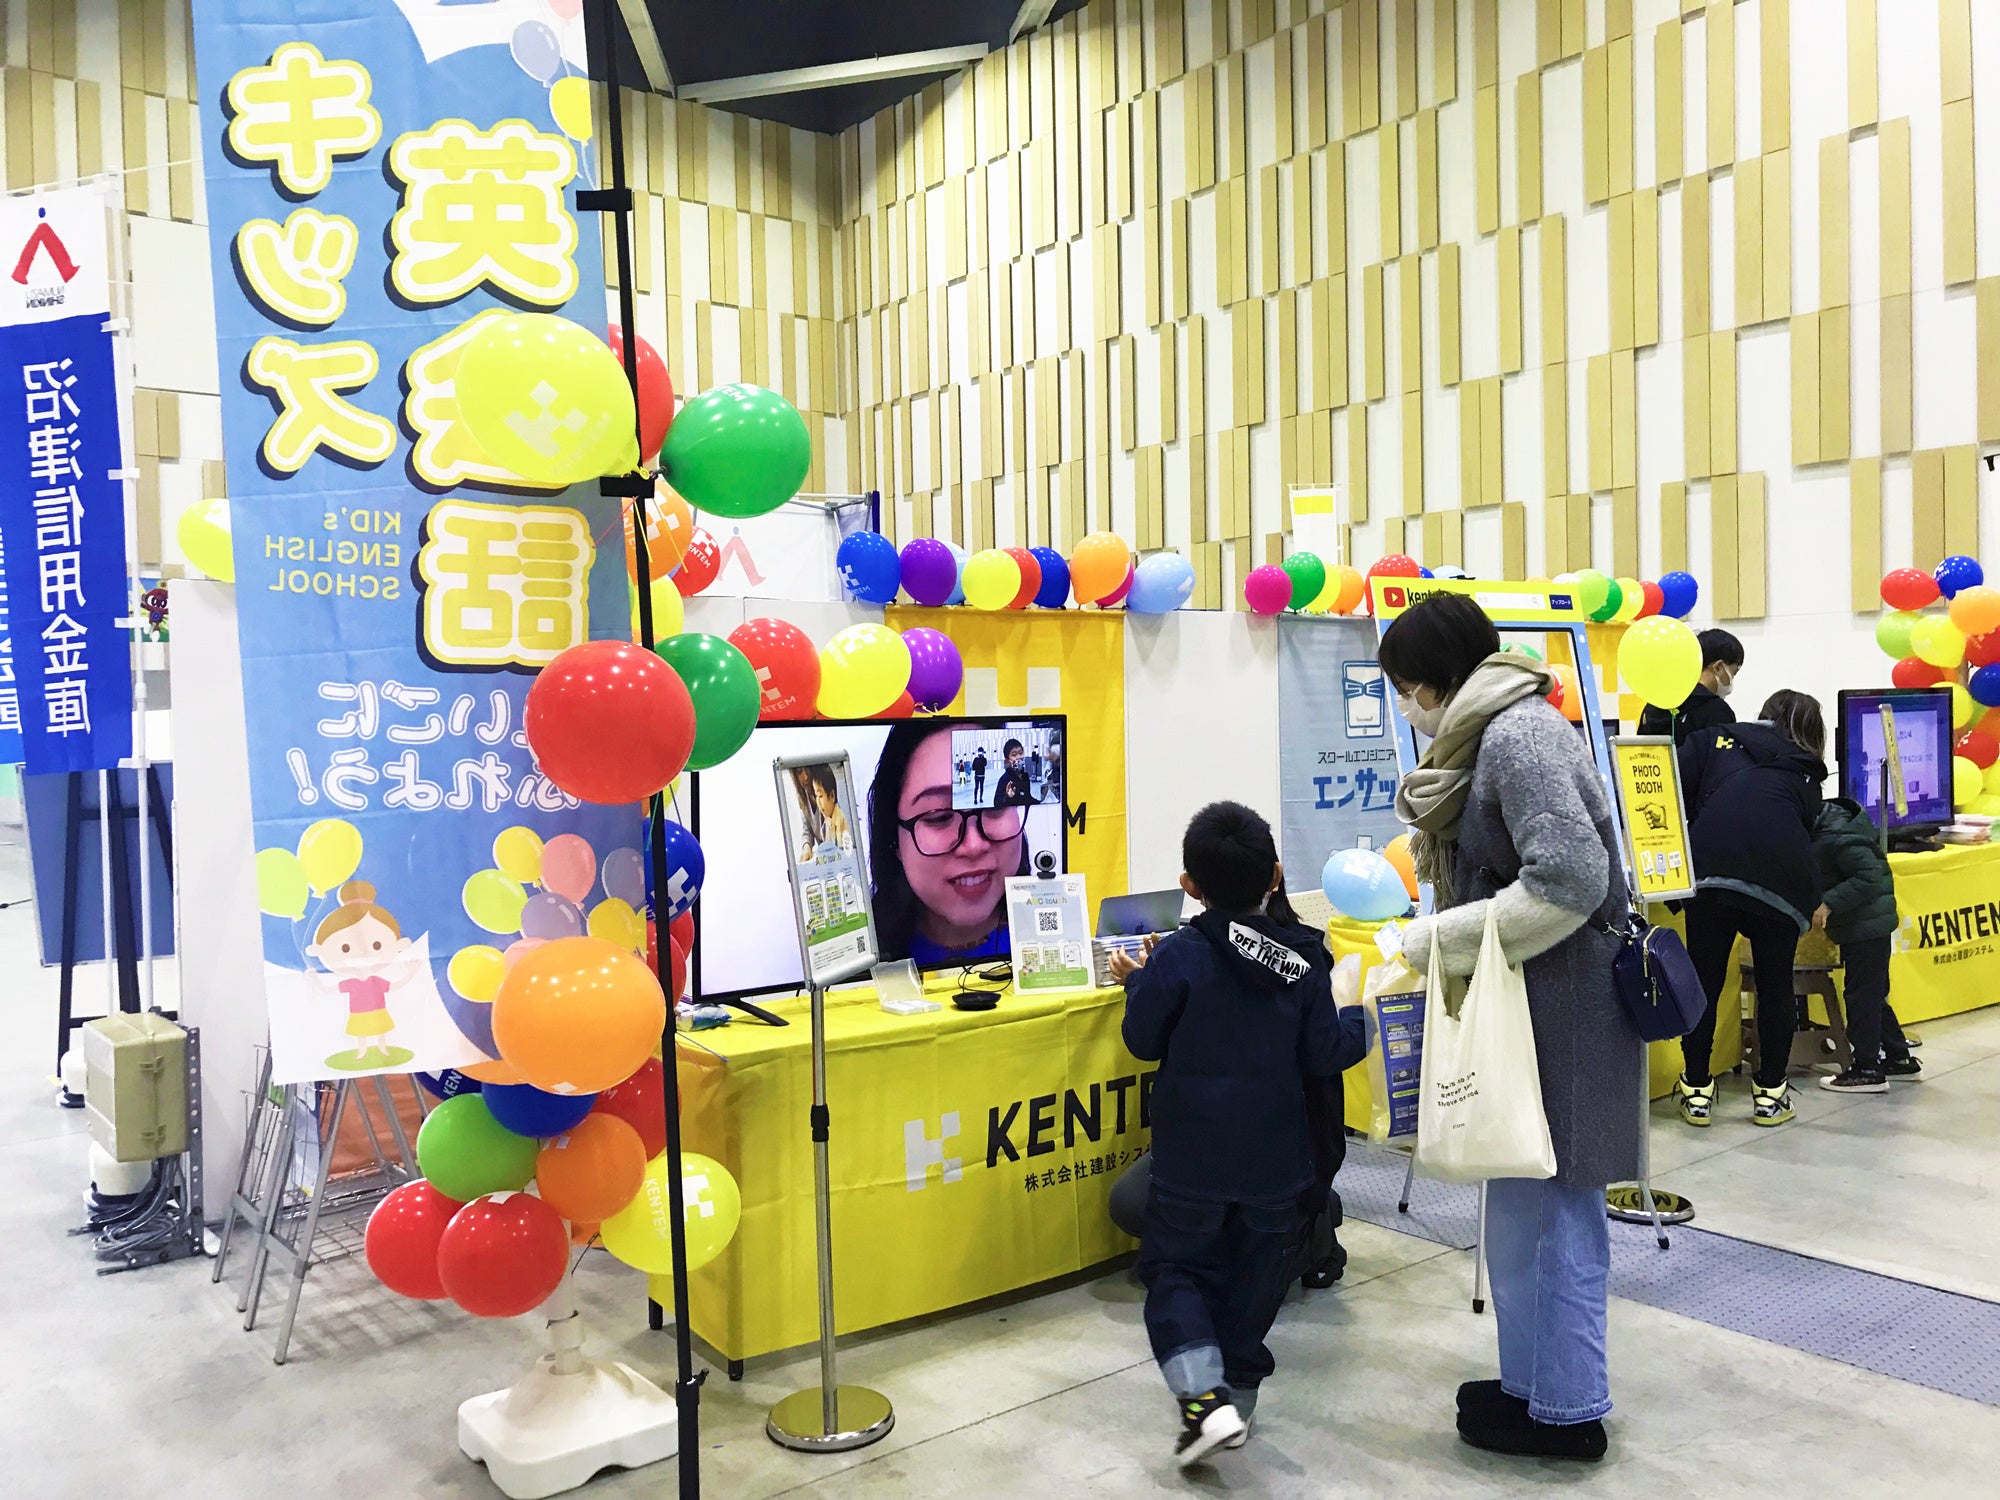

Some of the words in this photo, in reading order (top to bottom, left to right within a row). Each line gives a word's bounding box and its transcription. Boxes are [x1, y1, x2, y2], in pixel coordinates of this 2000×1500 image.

[687, 543, 712, 569] ENTEM
[760, 695, 797, 715] NTEM
[1632, 765, 1661, 778] PHOTO
[1635, 781, 1663, 794] BOOTH
[1256, 944, 1281, 971] THE
[986, 1070, 1156, 1169] KENT
[1024, 1145, 1151, 1193] 株式会社建設シス
